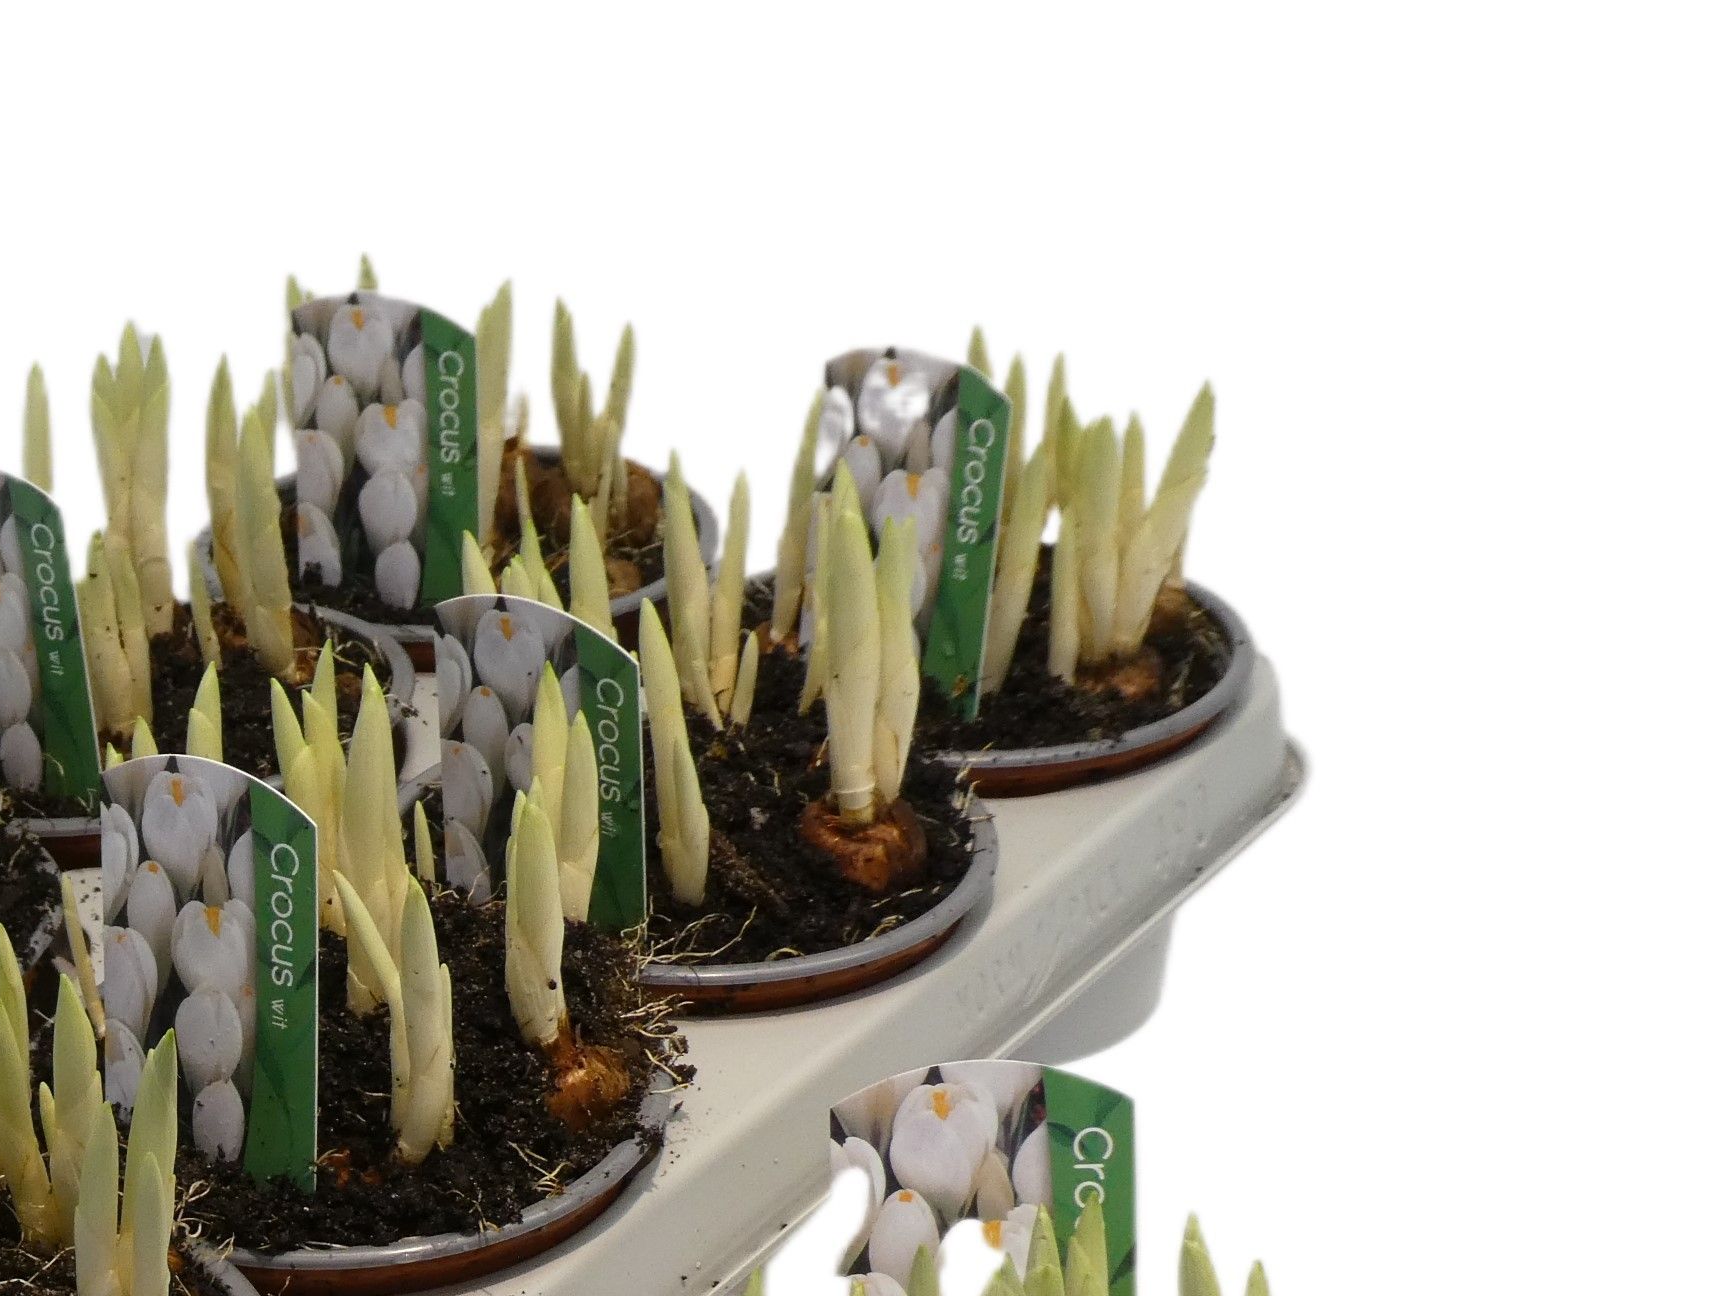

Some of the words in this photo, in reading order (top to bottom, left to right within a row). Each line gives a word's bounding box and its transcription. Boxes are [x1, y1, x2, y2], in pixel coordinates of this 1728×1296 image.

[437, 350, 465, 465] Crocus
[956, 418, 995, 545] Crocus
[31, 523, 64, 641] Crocus
[48, 650, 64, 676] wit
[596, 677, 624, 803] Crocus
[271, 843, 300, 987] Crocus
[271, 999, 288, 1030] wit
[1073, 1127, 1113, 1229] Cro
